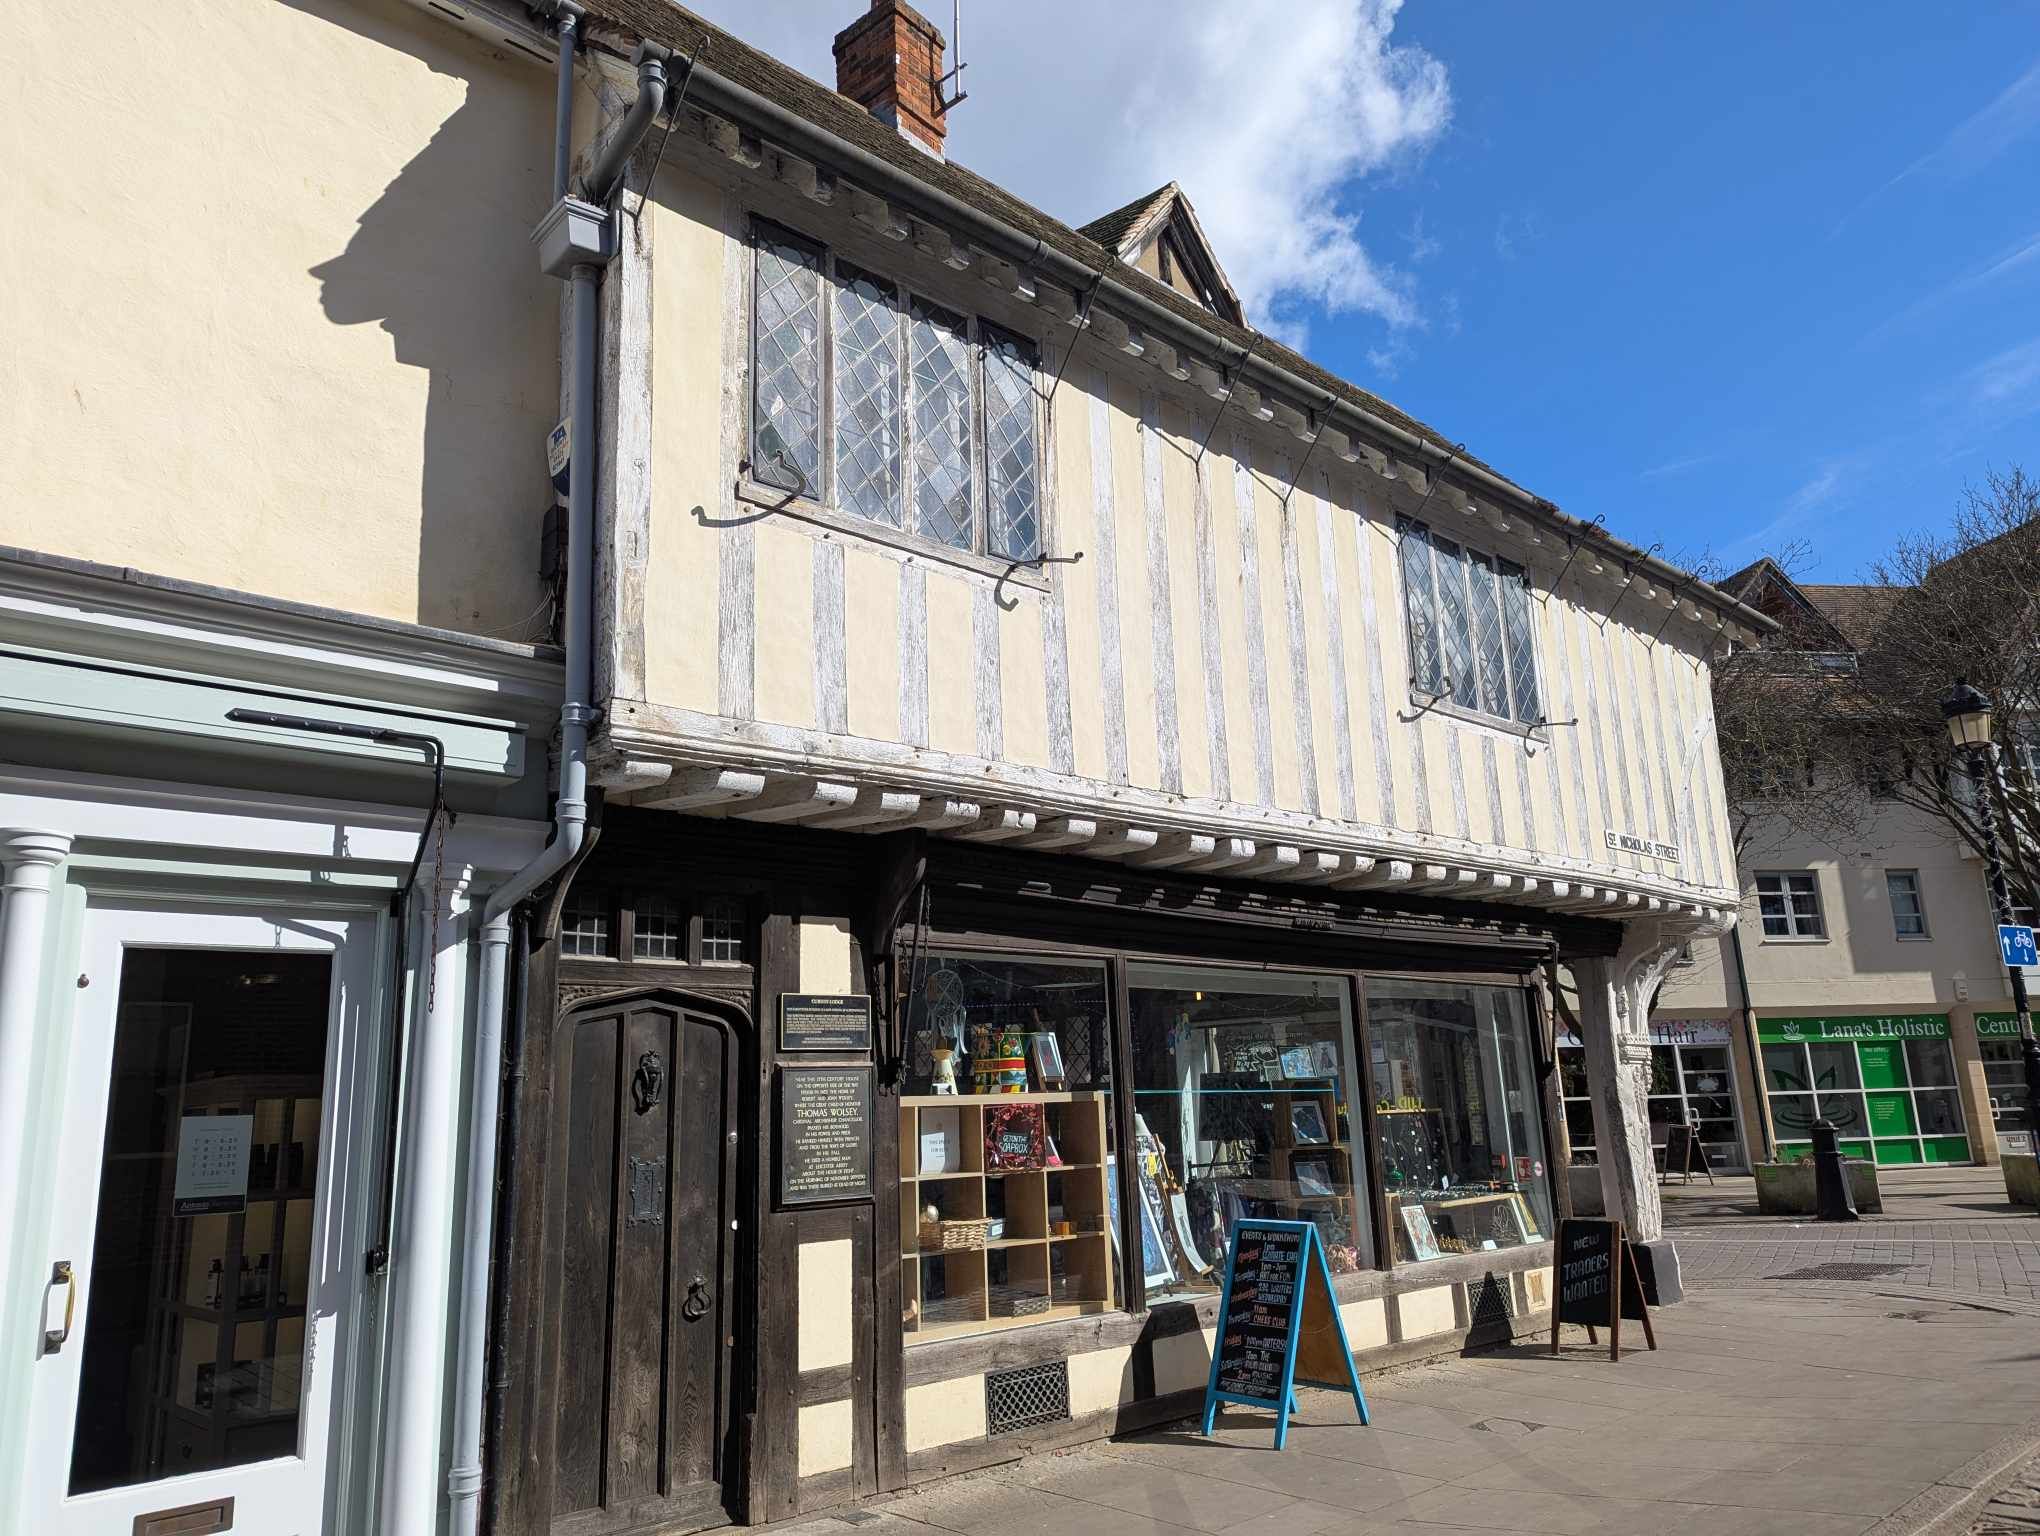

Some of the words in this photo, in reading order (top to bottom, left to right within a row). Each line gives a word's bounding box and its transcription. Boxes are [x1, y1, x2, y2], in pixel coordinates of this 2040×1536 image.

[1620, 835, 1653, 854] NICHOLAS
[1655, 844, 1680, 860] STREET
[1657, 1025, 1698, 1044] Hair
[1818, 1020, 1875, 1039] Lana's
[1877, 1018, 1946, 1037] Holistic
[797, 1108, 828, 1118] THOMAS
[999, 1142, 1028, 1154] SOAPBOX
[1241, 1230, 1262, 1240] EVENTS
[1573, 1233, 1600, 1251] NEW
[1563, 1252, 1609, 1281] TRADERS
[1563, 1275, 1608, 1305] WANTED
